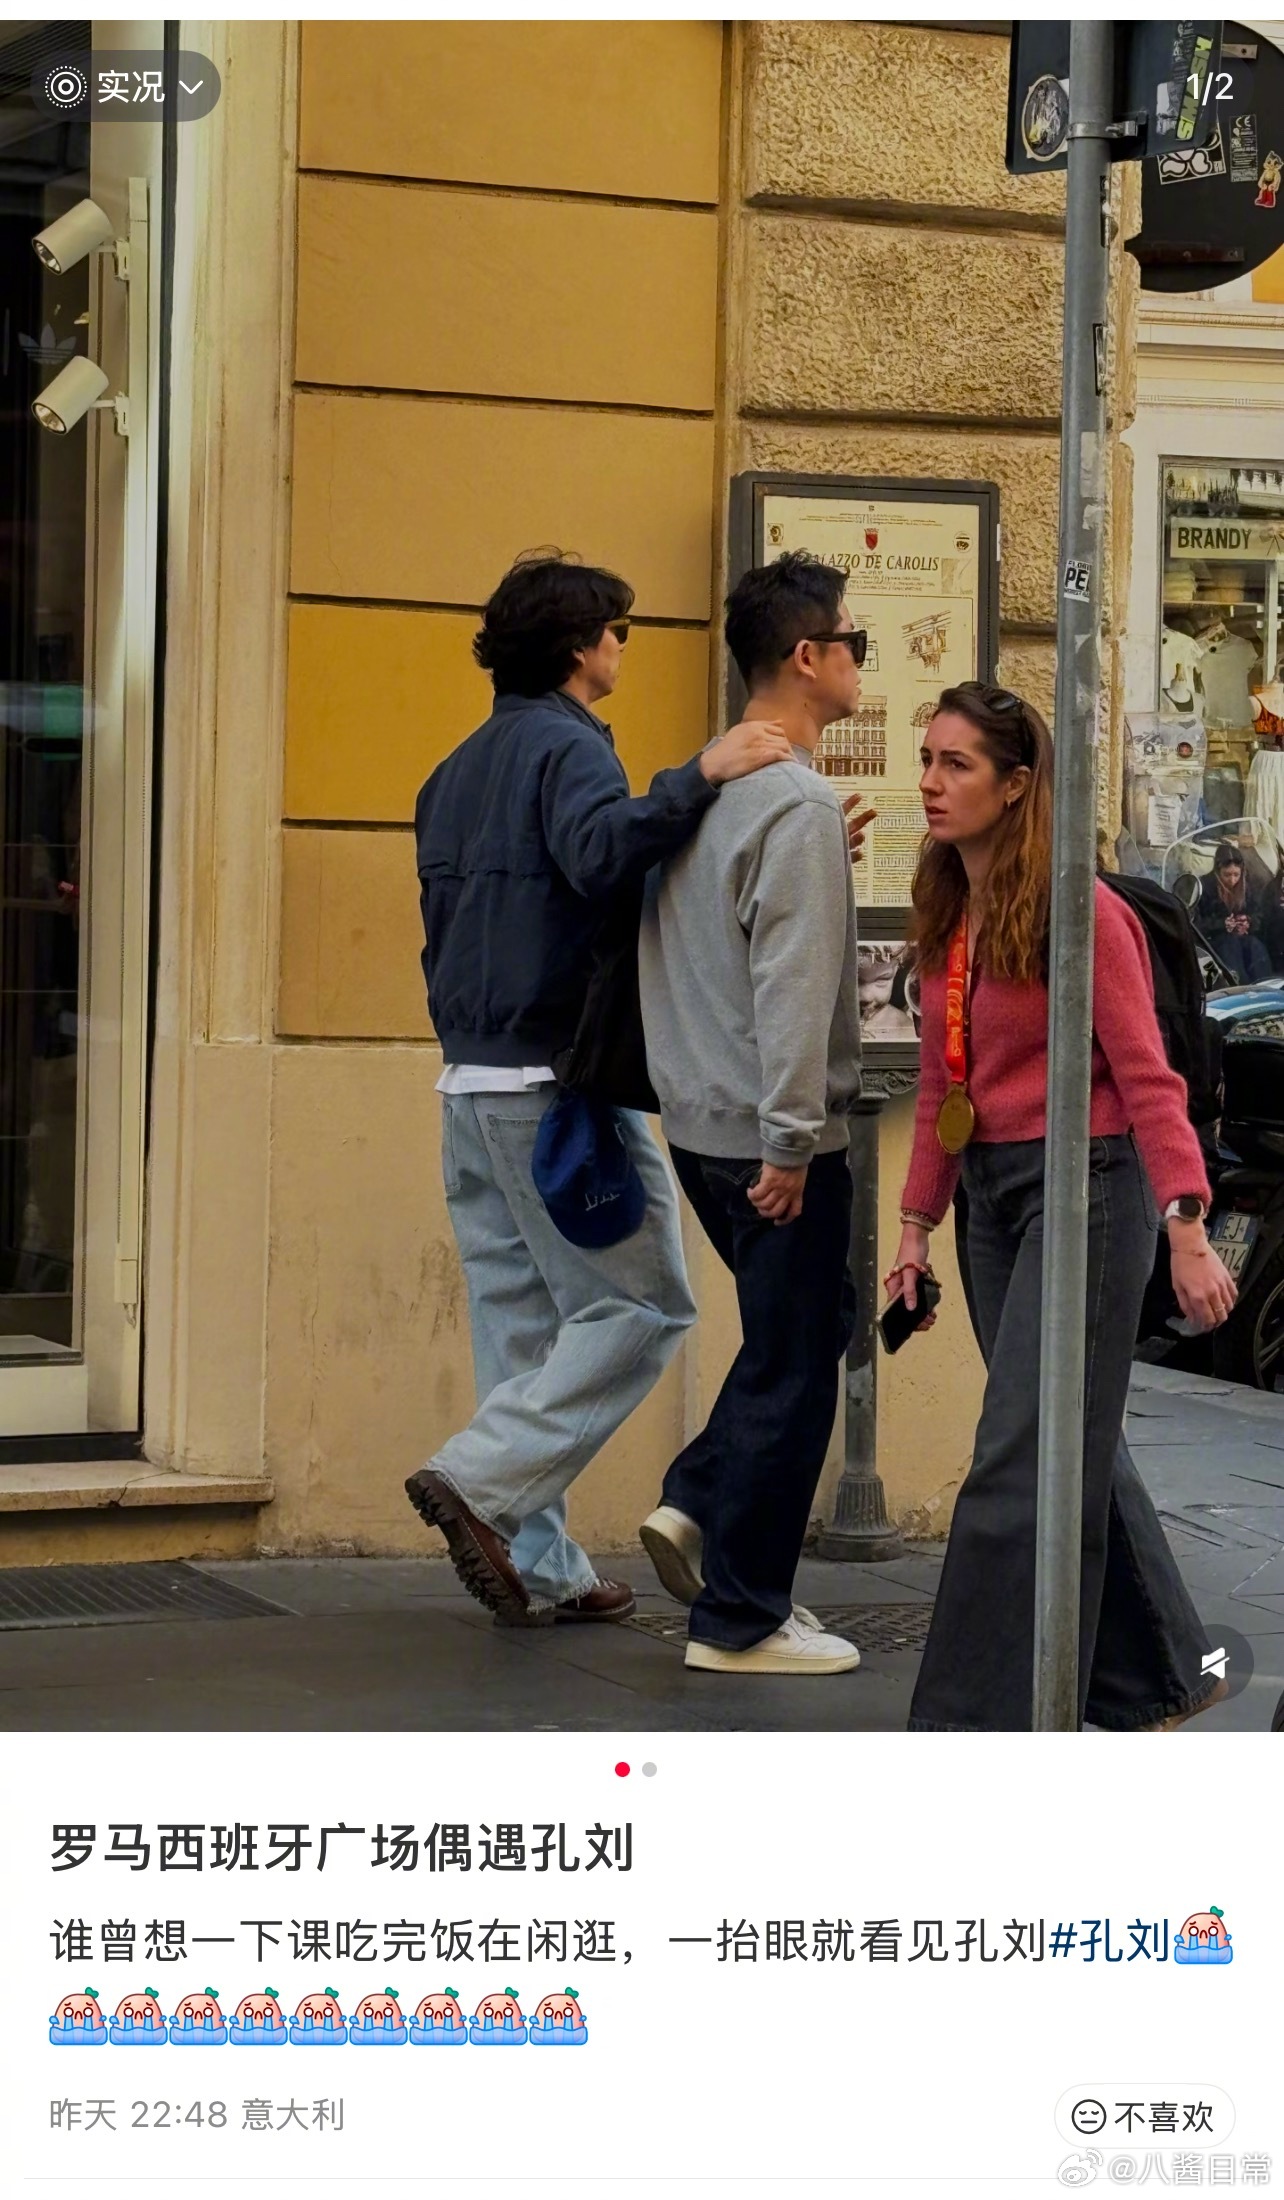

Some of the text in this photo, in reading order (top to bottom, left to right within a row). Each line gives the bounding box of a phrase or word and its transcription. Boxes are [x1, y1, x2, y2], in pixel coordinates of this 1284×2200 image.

[1177, 527, 1252, 550] BRANDY
[812, 553, 941, 571] ALAZZO DE CAROLIS
